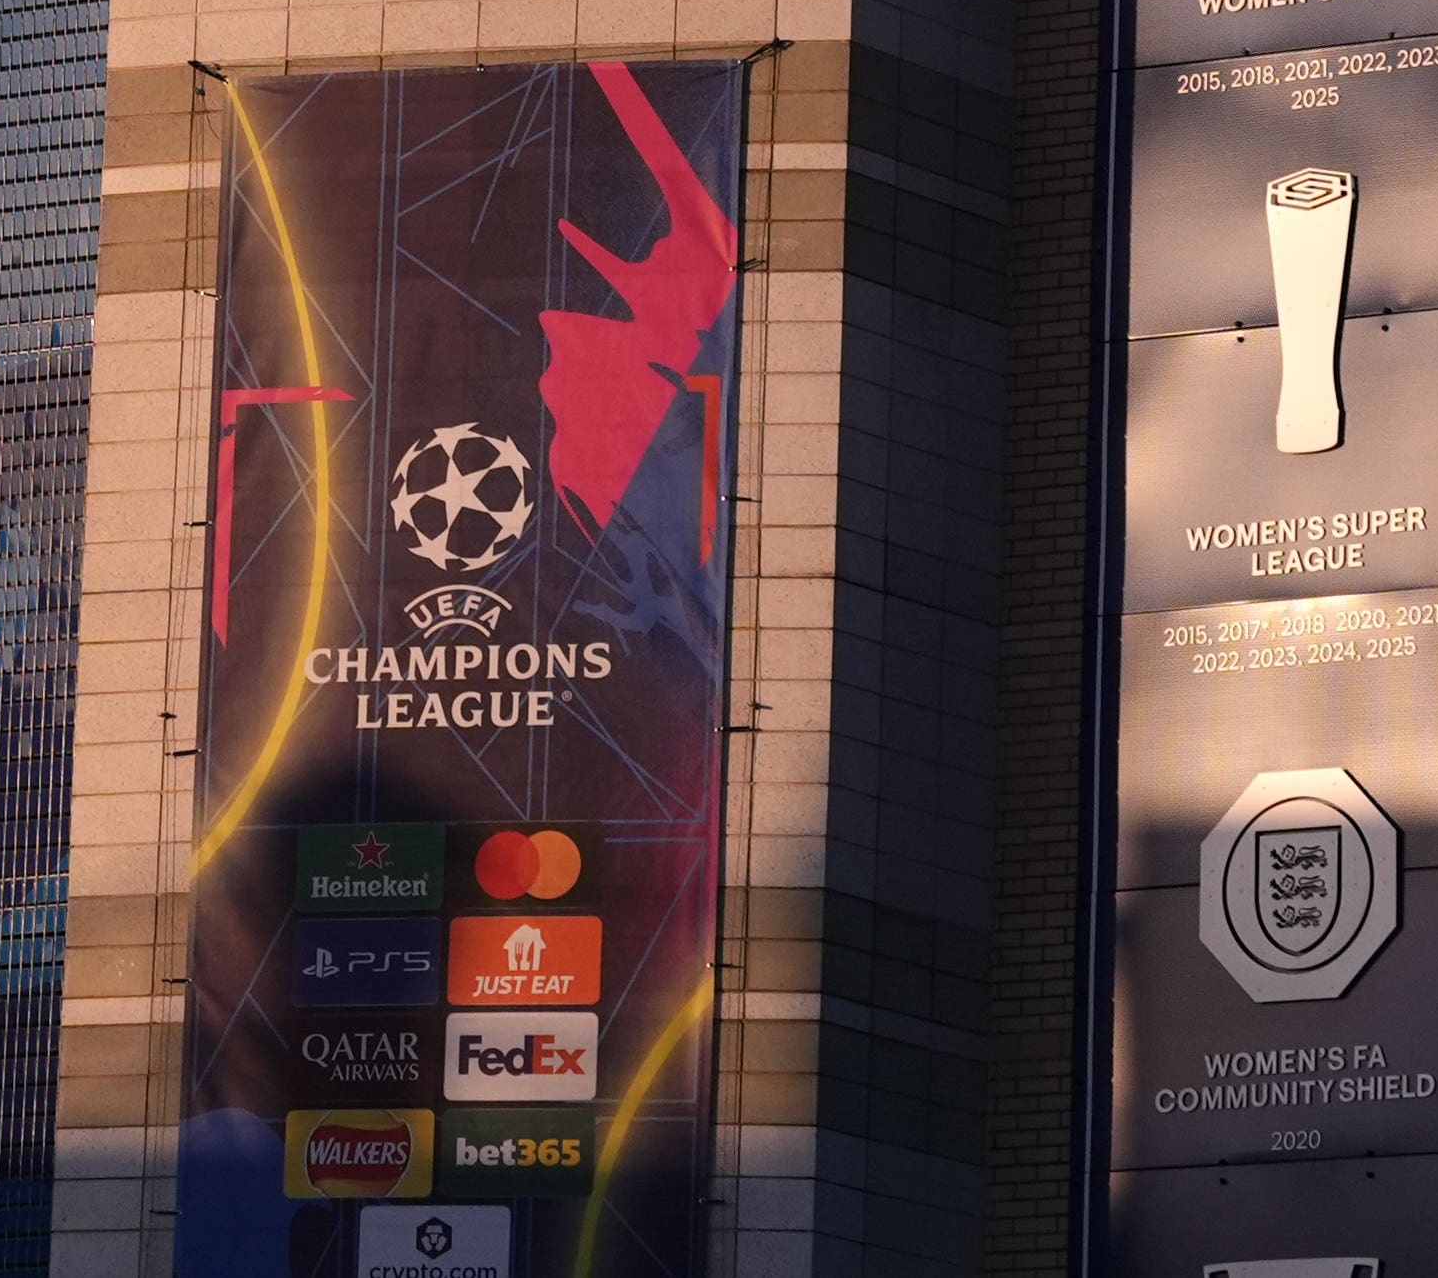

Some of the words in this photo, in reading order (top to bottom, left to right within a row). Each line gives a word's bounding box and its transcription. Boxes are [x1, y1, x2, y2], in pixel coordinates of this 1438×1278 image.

[1177, 72, 1227, 95] 2015,
[1230, 66, 1280, 90] 2018,
[1284, 60, 1333, 83] 2021,
[1339, 55, 1392, 77] 2022,
[1290, 86, 1339, 111] 2025
[1186, 516, 1325, 551] WOMEN'S
[1330, 507, 1427, 538] SUPER
[1250, 543, 1364, 577] LEAGUE
[408, 594, 502, 632] UEFA
[1164, 626, 1212, 647] 2015,
[1336, 609, 1390, 631] 2020,
[304, 643, 612, 685] CHAMPIONS
[1193, 651, 1245, 673] 2022,
[1248, 647, 1302, 668] 2023,
[1308, 642, 1360, 664] 2024,
[1366, 636, 1416, 658] 2025
[311, 875, 428, 899] Heineken
[348, 951, 432, 972] PS5
[473, 976, 527, 996] JUST
[531, 976, 574, 994] EAT
[302, 1032, 418, 1067] QATAR
[458, 1034, 586, 1076] FedEx
[1205, 1048, 1346, 1078] WOMEN'S
[1353, 1044, 1387, 1069] FA
[330, 1063, 419, 1082] AIRWAYS
[1154, 1079, 1336, 1115] COMMUNITY
[1340, 1072, 1436, 1101] SHIELD
[309, 1140, 408, 1166] WALKERS
[455, 1138, 580, 1166] bet365
[1271, 1129, 1321, 1152] 2020
